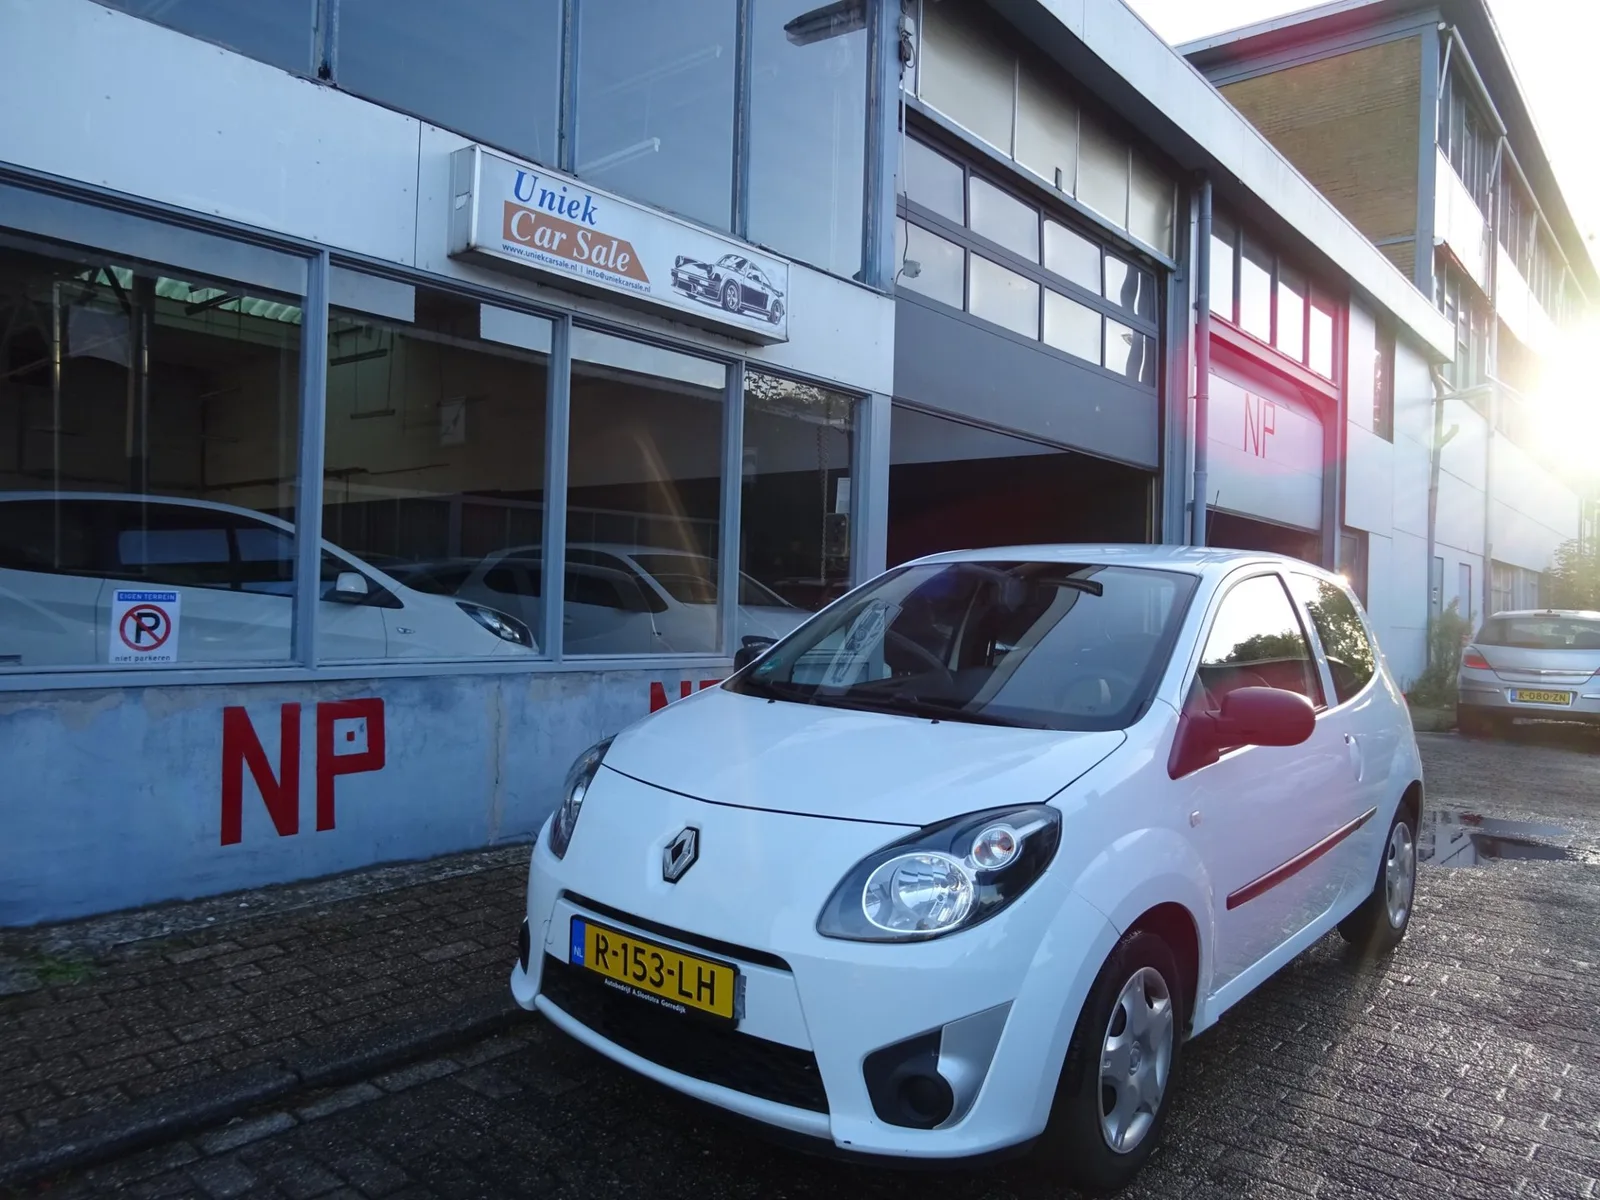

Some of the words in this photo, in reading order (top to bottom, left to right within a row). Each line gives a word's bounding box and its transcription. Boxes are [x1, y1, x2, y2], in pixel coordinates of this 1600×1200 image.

[513, 169, 598, 225] Uniek
[510, 209, 566, 252] Car
[573, 230, 630, 272] Sale
[502, 243, 578, 271] www.uniekcarsale.nl
[586, 266, 651, 293] info@uniekcarsale.nl
[1243, 392, 1276, 459] NP
[119, 592, 142, 600] EIGEN
[144, 593, 176, 601] TERREIN
[134, 654, 171, 662] parkeren
[1518, 691, 1567, 702] K-080-ZN
[220, 697, 386, 846] NP
[573, 944, 584, 959] NL
[595, 932, 716, 1006] R-153-LH
[604, 977, 631, 994] Autobedrijf
[660, 999, 687, 1014] Gorredijk
